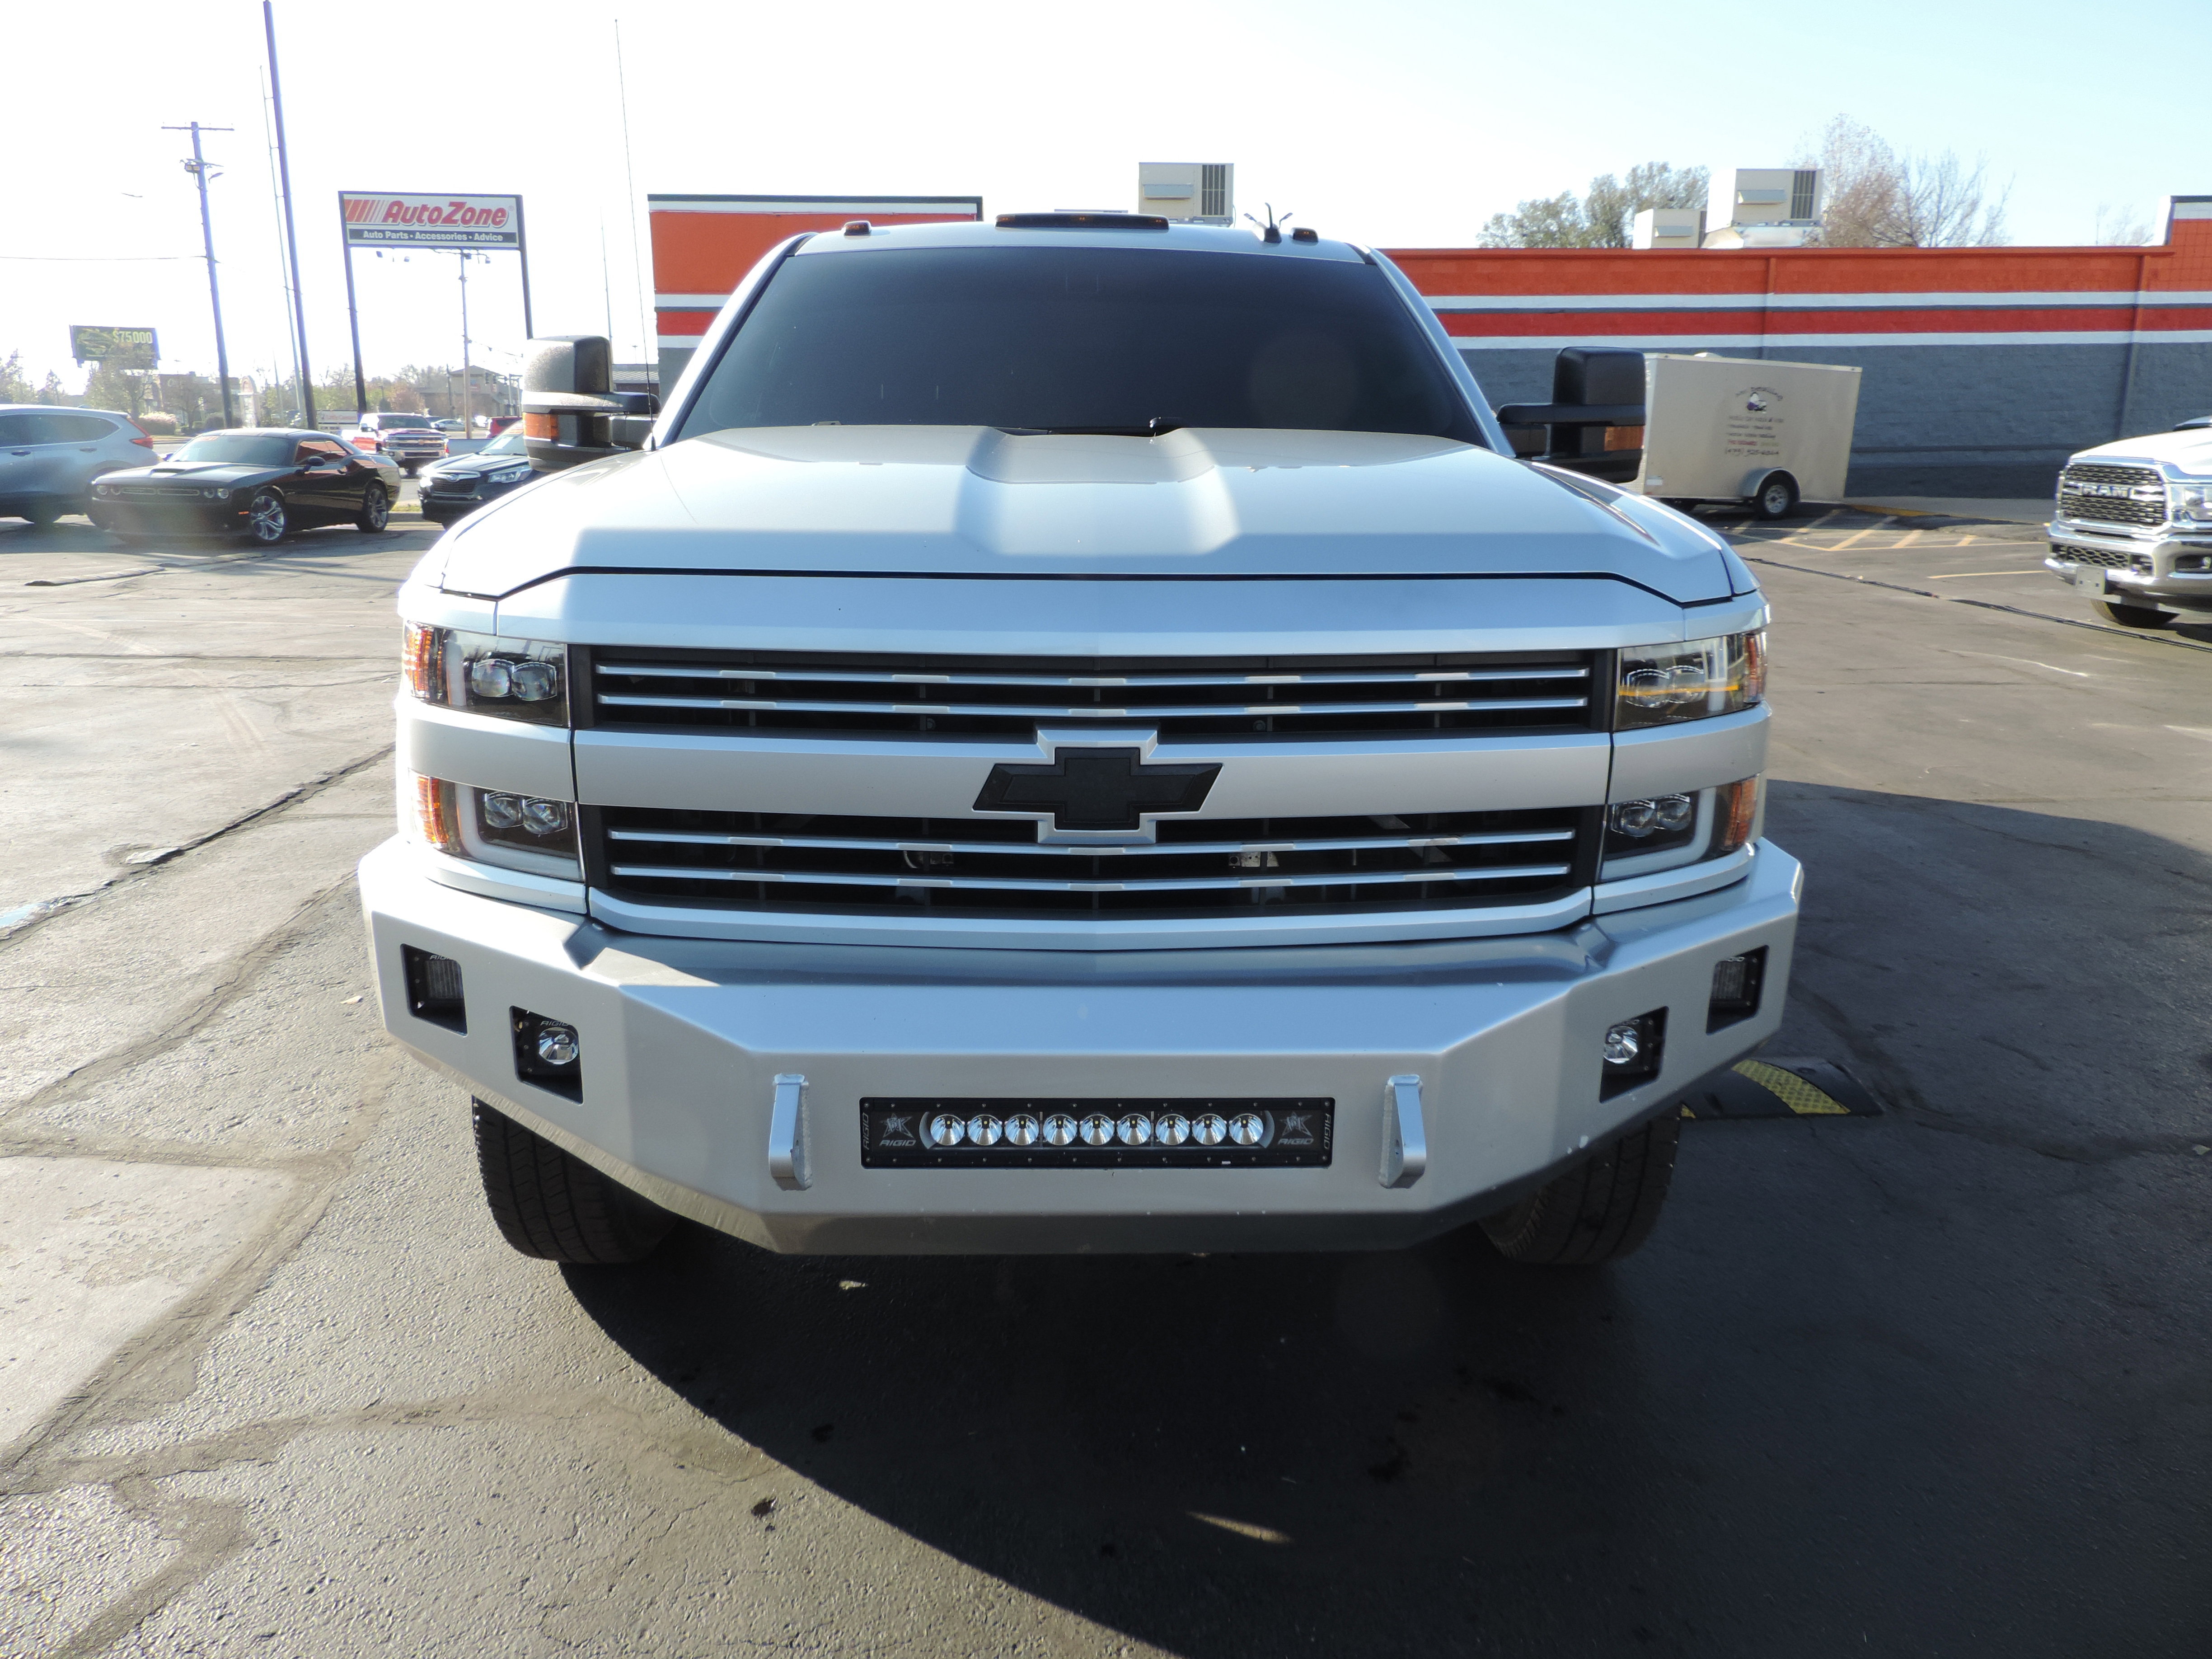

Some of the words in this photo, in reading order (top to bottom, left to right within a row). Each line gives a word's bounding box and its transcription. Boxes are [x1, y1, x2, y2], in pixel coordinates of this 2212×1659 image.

[382, 200, 507, 227] AutoZone
[363, 230, 384, 239] Auto
[385, 231, 408, 239] Parts
[415, 232, 468, 241] Accessories
[474, 233, 503, 242] Advice
[2083, 484, 2129, 498] RAM
[1324, 1113, 1332, 1150] RIGID
